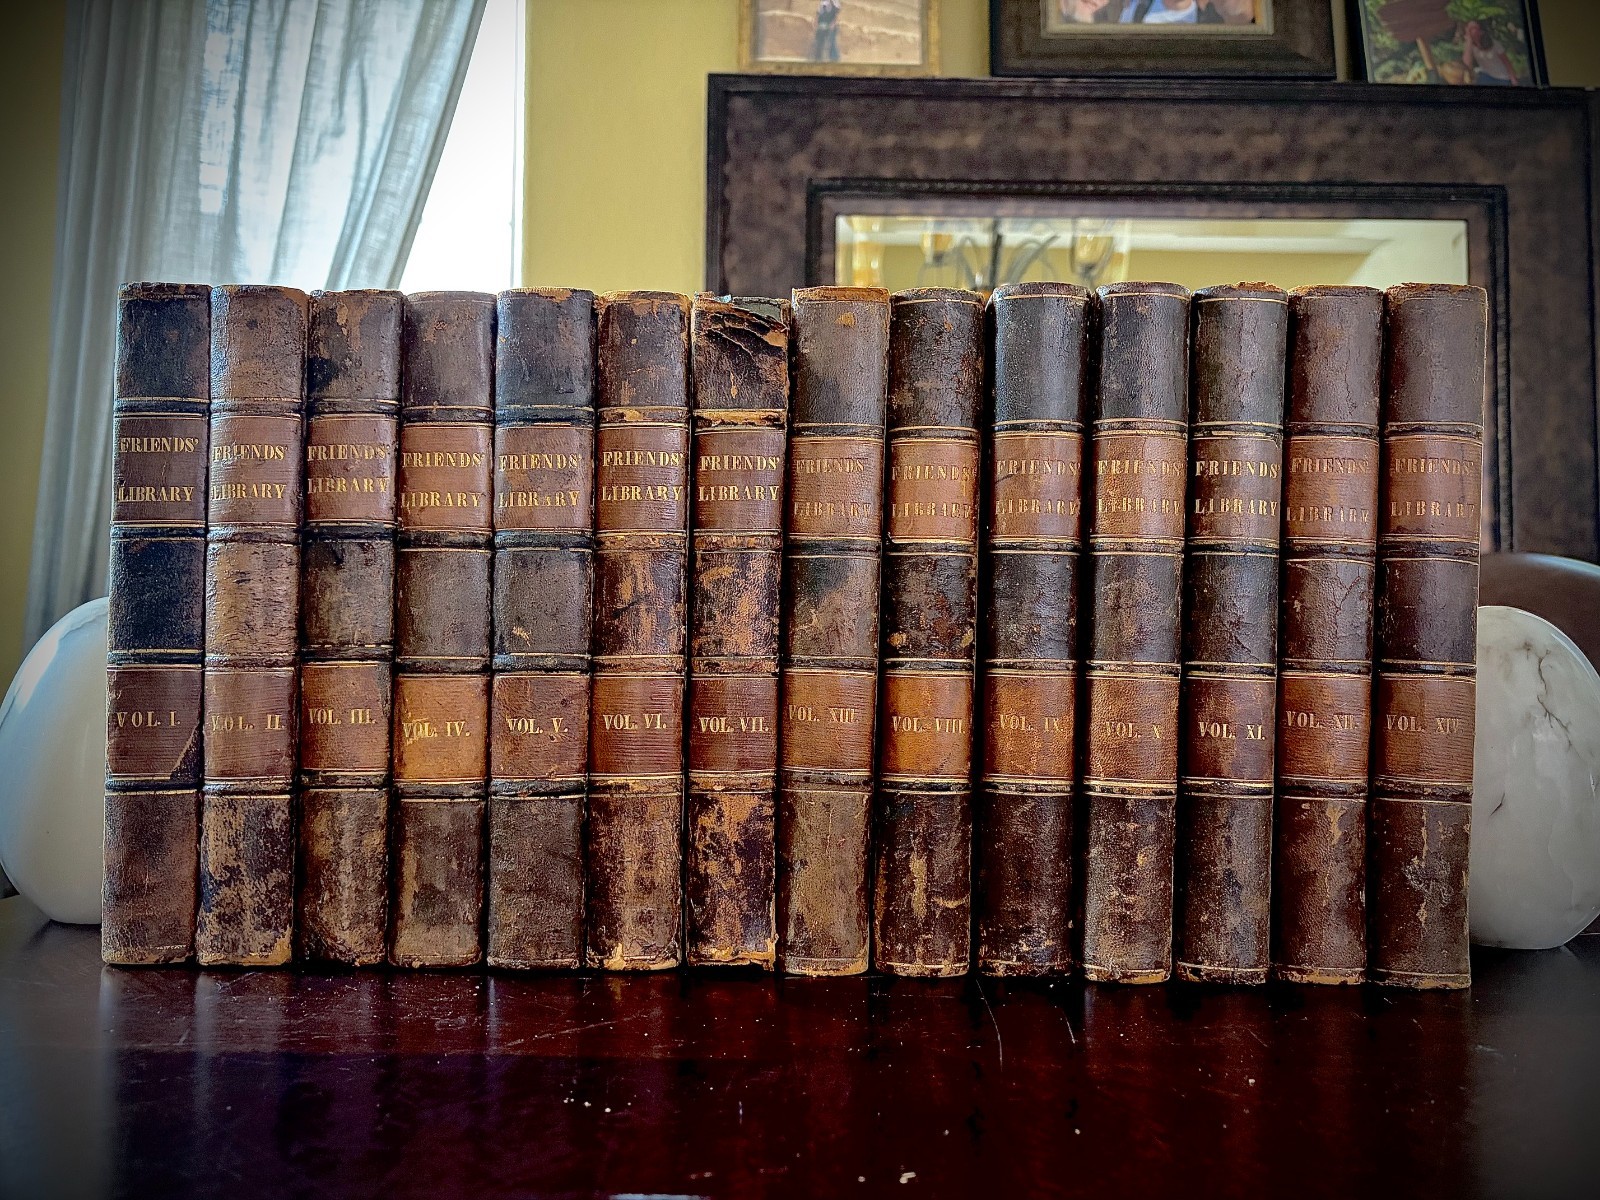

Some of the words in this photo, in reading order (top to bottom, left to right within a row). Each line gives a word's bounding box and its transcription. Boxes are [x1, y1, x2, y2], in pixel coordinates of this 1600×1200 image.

[120, 437, 199, 453] FRIENDS'
[499, 453, 582, 472] FRIENDS'
[602, 451, 683, 467] FRIENDS'
[700, 455, 780, 471] FRIENDS'
[118, 486, 194, 502] LIBRARY
[212, 484, 287, 501] LIBRARY
[307, 478, 390, 494] LIBRARY
[602, 485, 682, 501] LIBRARY
[699, 485, 780, 501] LIBRARY
[401, 491, 481, 508] LIBRARY
[499, 490, 580, 508] LIBRARY
[1195, 499, 1277, 517] LIBRARY
[116, 711, 161, 728] VOL.
[169, 712, 181, 727] I.
[308, 708, 341, 725] VOL.
[350, 708, 376, 725] III.
[603, 714, 638, 729] VOL.
[644, 713, 667, 729] VI.
[699, 716, 734, 733] VOL.
[739, 717, 769, 733] VII.
[446, 721, 471, 737] IV.
[507, 718, 544, 735] VOL.
[551, 718, 569, 734] V.
[1198, 722, 1235, 739] VOL.
[1246, 724, 1265, 741] XI.
